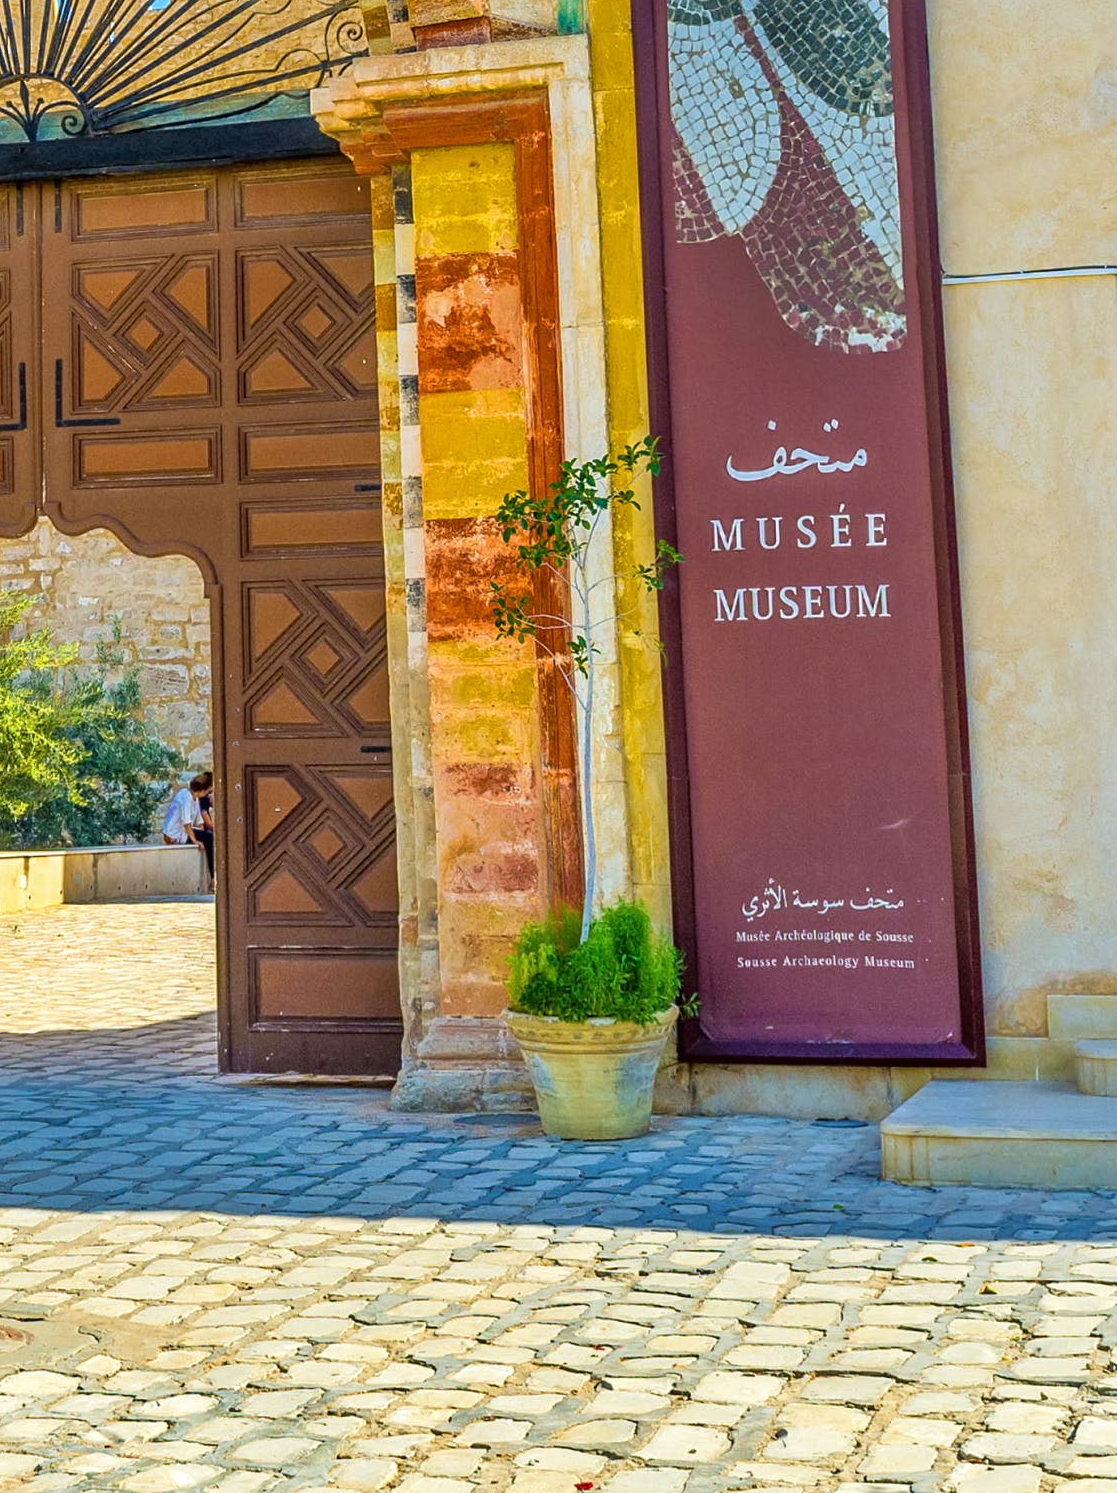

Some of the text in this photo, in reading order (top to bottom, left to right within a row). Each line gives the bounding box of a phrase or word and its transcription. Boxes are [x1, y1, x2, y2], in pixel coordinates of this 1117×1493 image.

[726, 419, 868, 482] متحف
[710, 503, 888, 552] MUSÉE
[713, 584, 892, 622] MUSEUM
[792, 889, 845, 915] سوسة
[849, 887, 905, 911] متحف
[735, 929, 915, 944] Musée Archéologique de Sousse
[737, 954, 916, 970] Sousse Archaeology Museum
